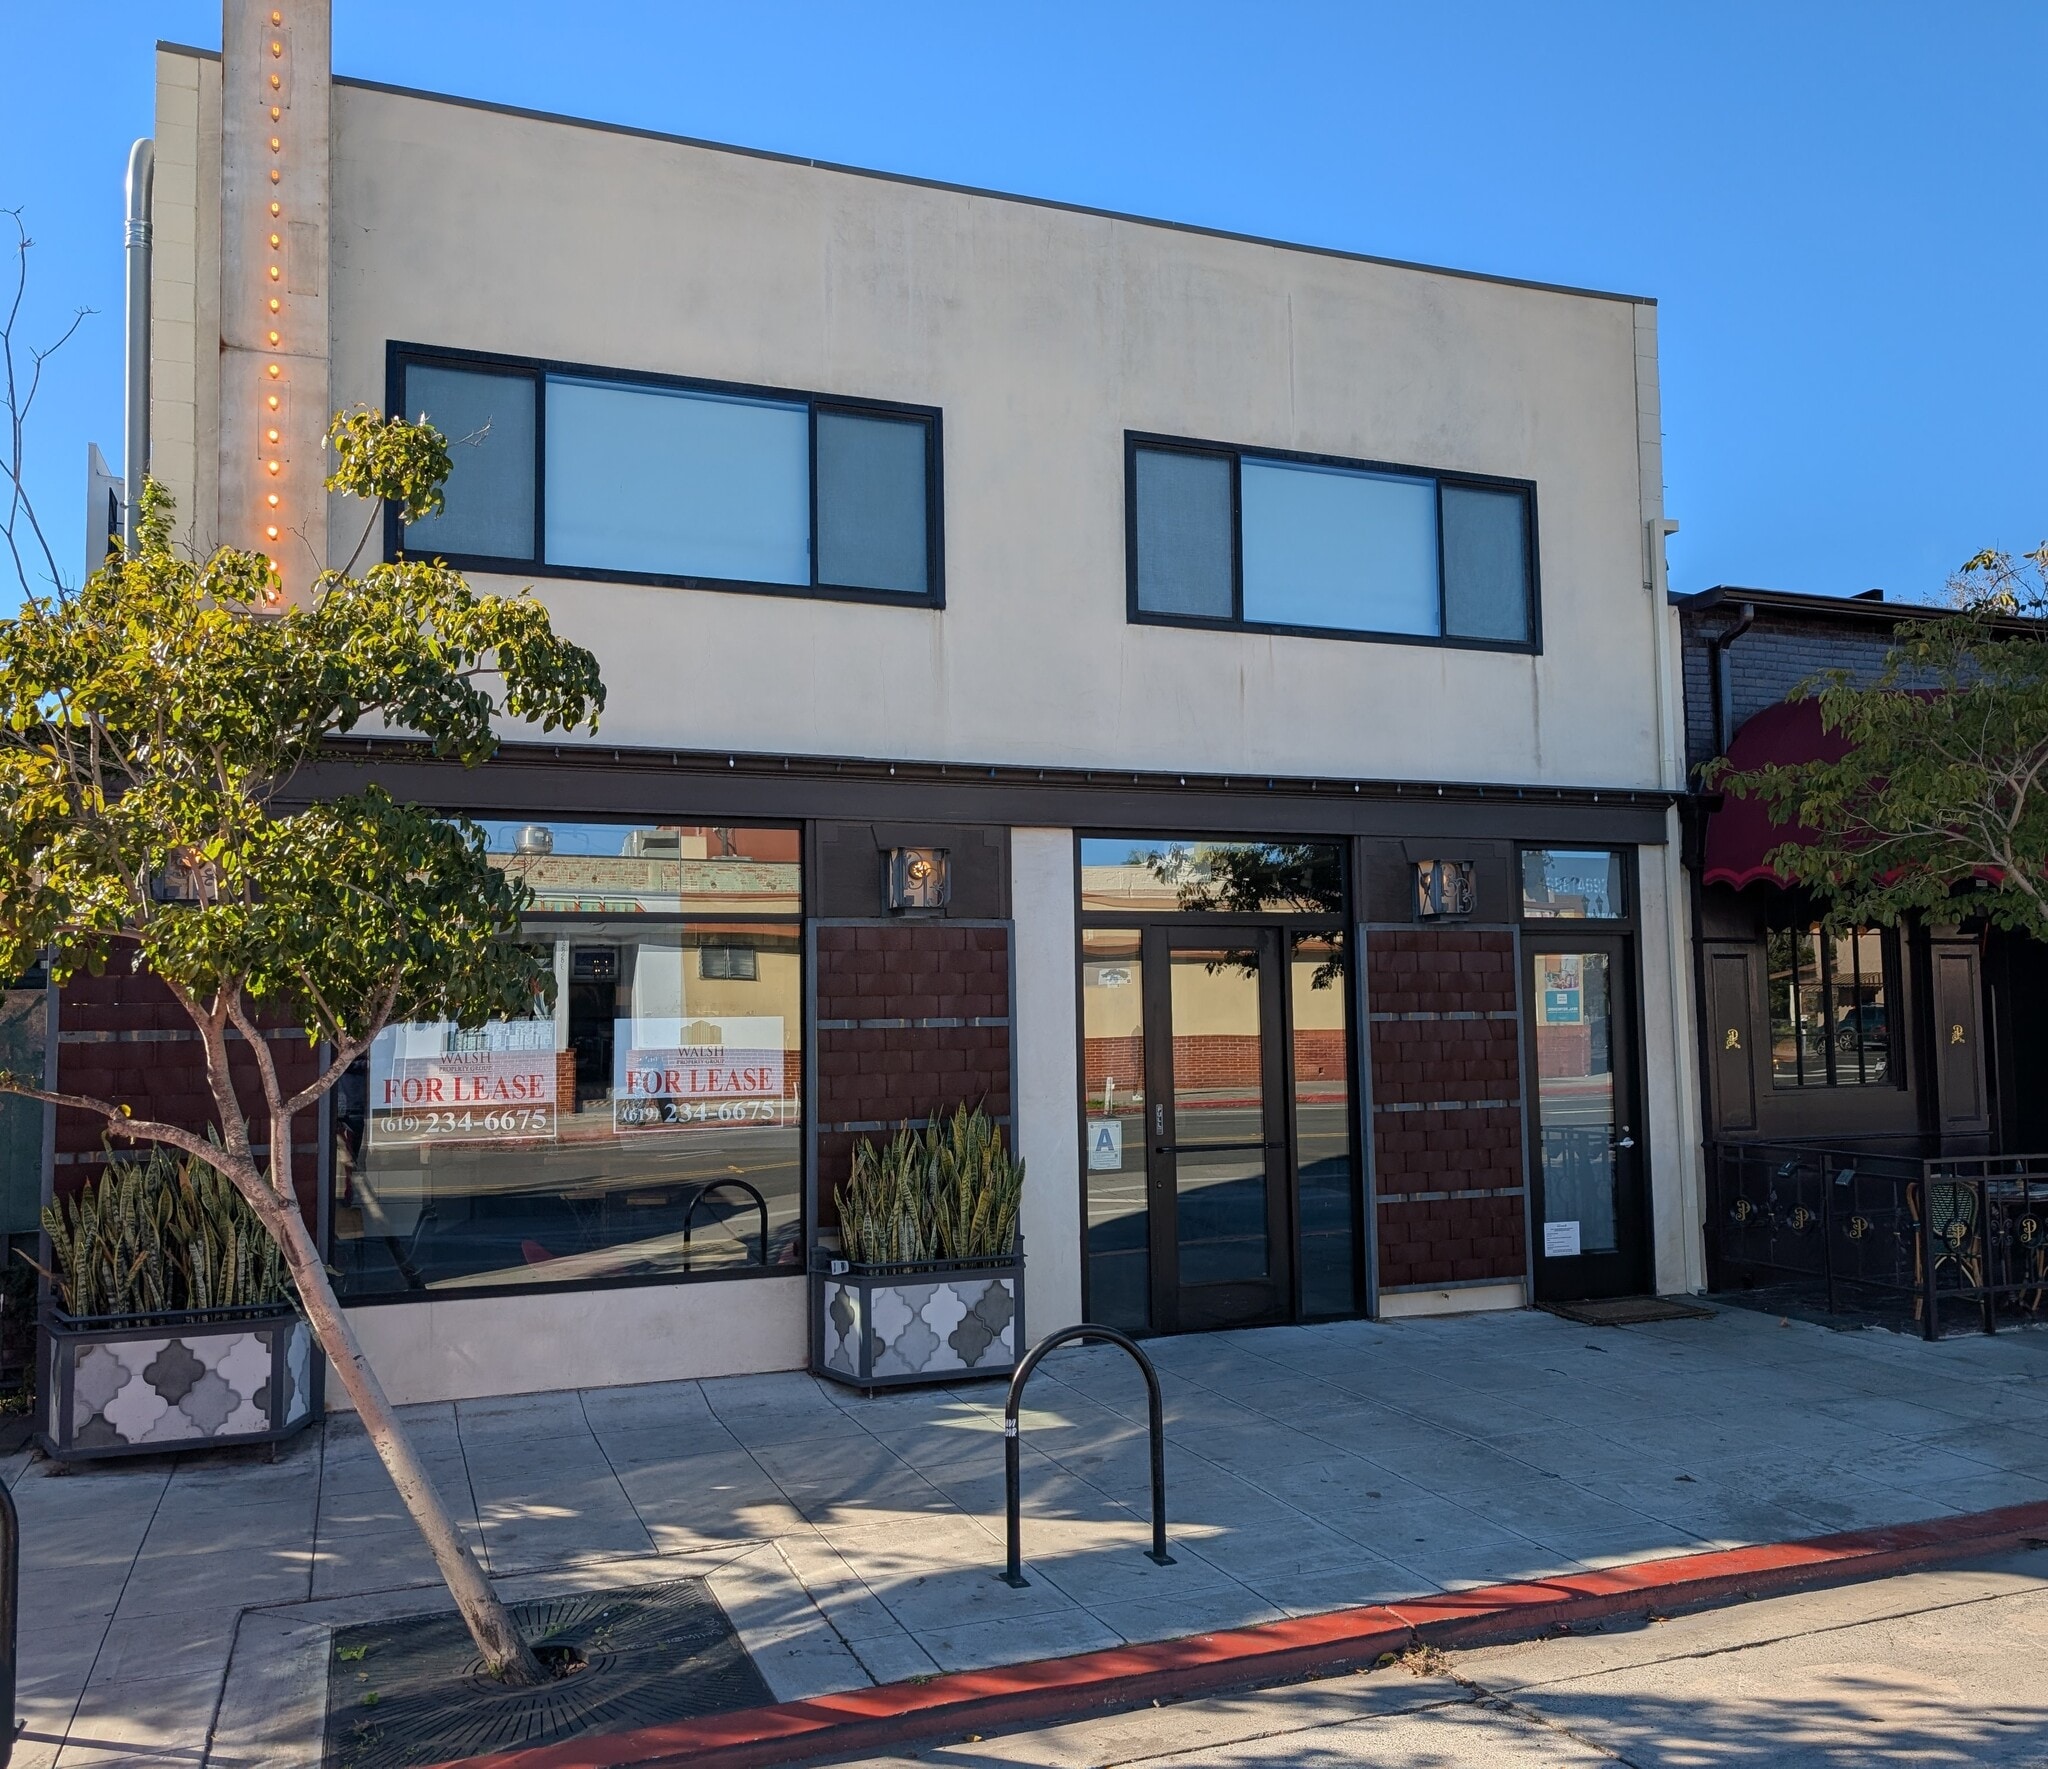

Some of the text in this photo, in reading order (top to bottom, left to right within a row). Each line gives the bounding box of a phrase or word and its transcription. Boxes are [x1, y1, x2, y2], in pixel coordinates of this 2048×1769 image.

[440, 1052, 491, 1065] WALSH
[678, 1045, 724, 1057] WALSH
[383, 1074, 545, 1104] FOR LEASE
[627, 1067, 774, 1095] FOR LEASE
[380, 1108, 547, 1134] (619) 234-6675
[623, 1100, 775, 1124] (619) 234-6675
[1096, 1128, 1115, 1152] A
[2020, 1218, 2037, 1243] P
